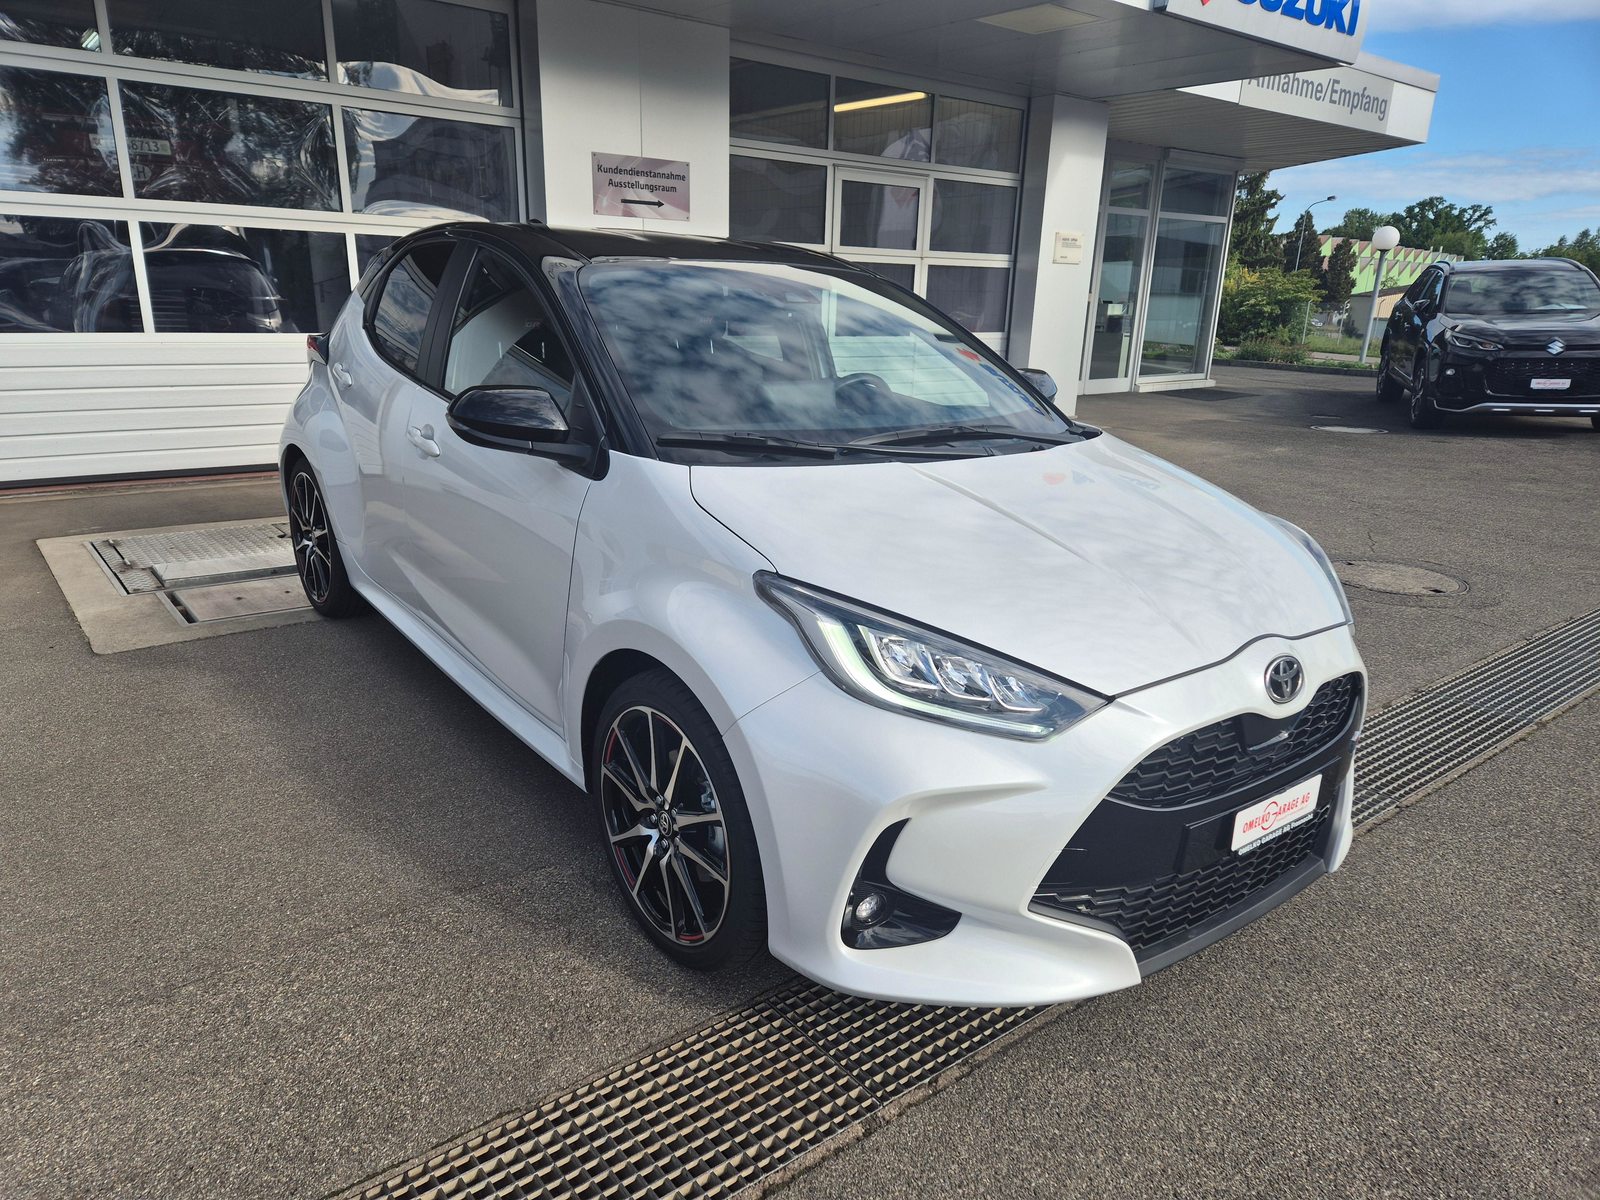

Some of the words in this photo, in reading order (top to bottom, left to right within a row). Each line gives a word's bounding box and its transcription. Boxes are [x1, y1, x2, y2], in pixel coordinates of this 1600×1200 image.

[1237, 0, 1361, 36] ZUKI
[597, 164, 686, 182] Kundendienstannahme
[608, 178, 677, 193] Ausstellungsraum
[1243, 811, 1270, 833] OMELKO
[1261, 798, 1300, 830] GARAGE
[1302, 792, 1311, 804] AG
[1262, 828, 1283, 844] GARAGE
